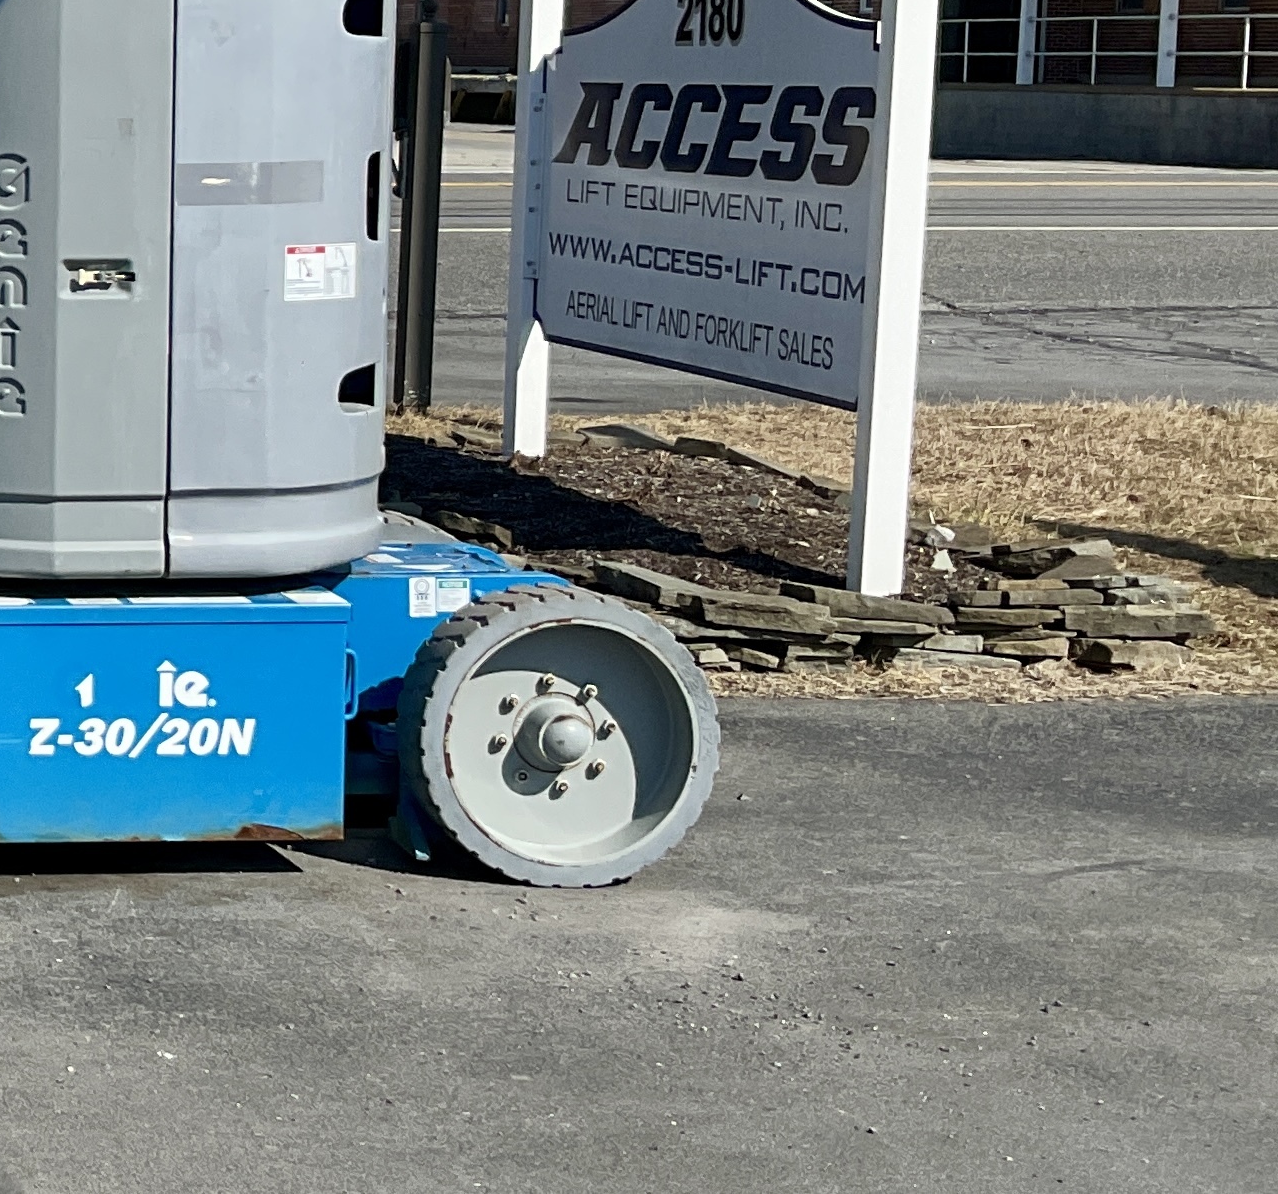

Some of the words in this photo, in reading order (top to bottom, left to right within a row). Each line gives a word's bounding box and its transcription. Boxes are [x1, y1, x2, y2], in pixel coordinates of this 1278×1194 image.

[554, 83, 876, 185] ACCESS
[566, 178, 615, 206] LIFT
[624, 183, 785, 230] EQUIPMENT,
[795, 199, 848, 233] INC.
[549, 231, 866, 304] WWW.ACCESS-LIFT.COM
[566, 290, 618, 325] AERIAL
[622, 300, 654, 331] LIFT
[656, 306, 690, 339] AND
[695, 312, 774, 357] FORKLIFT
[778, 328, 835, 370] SALES
[28, 712, 256, 759] Z-30/20N
